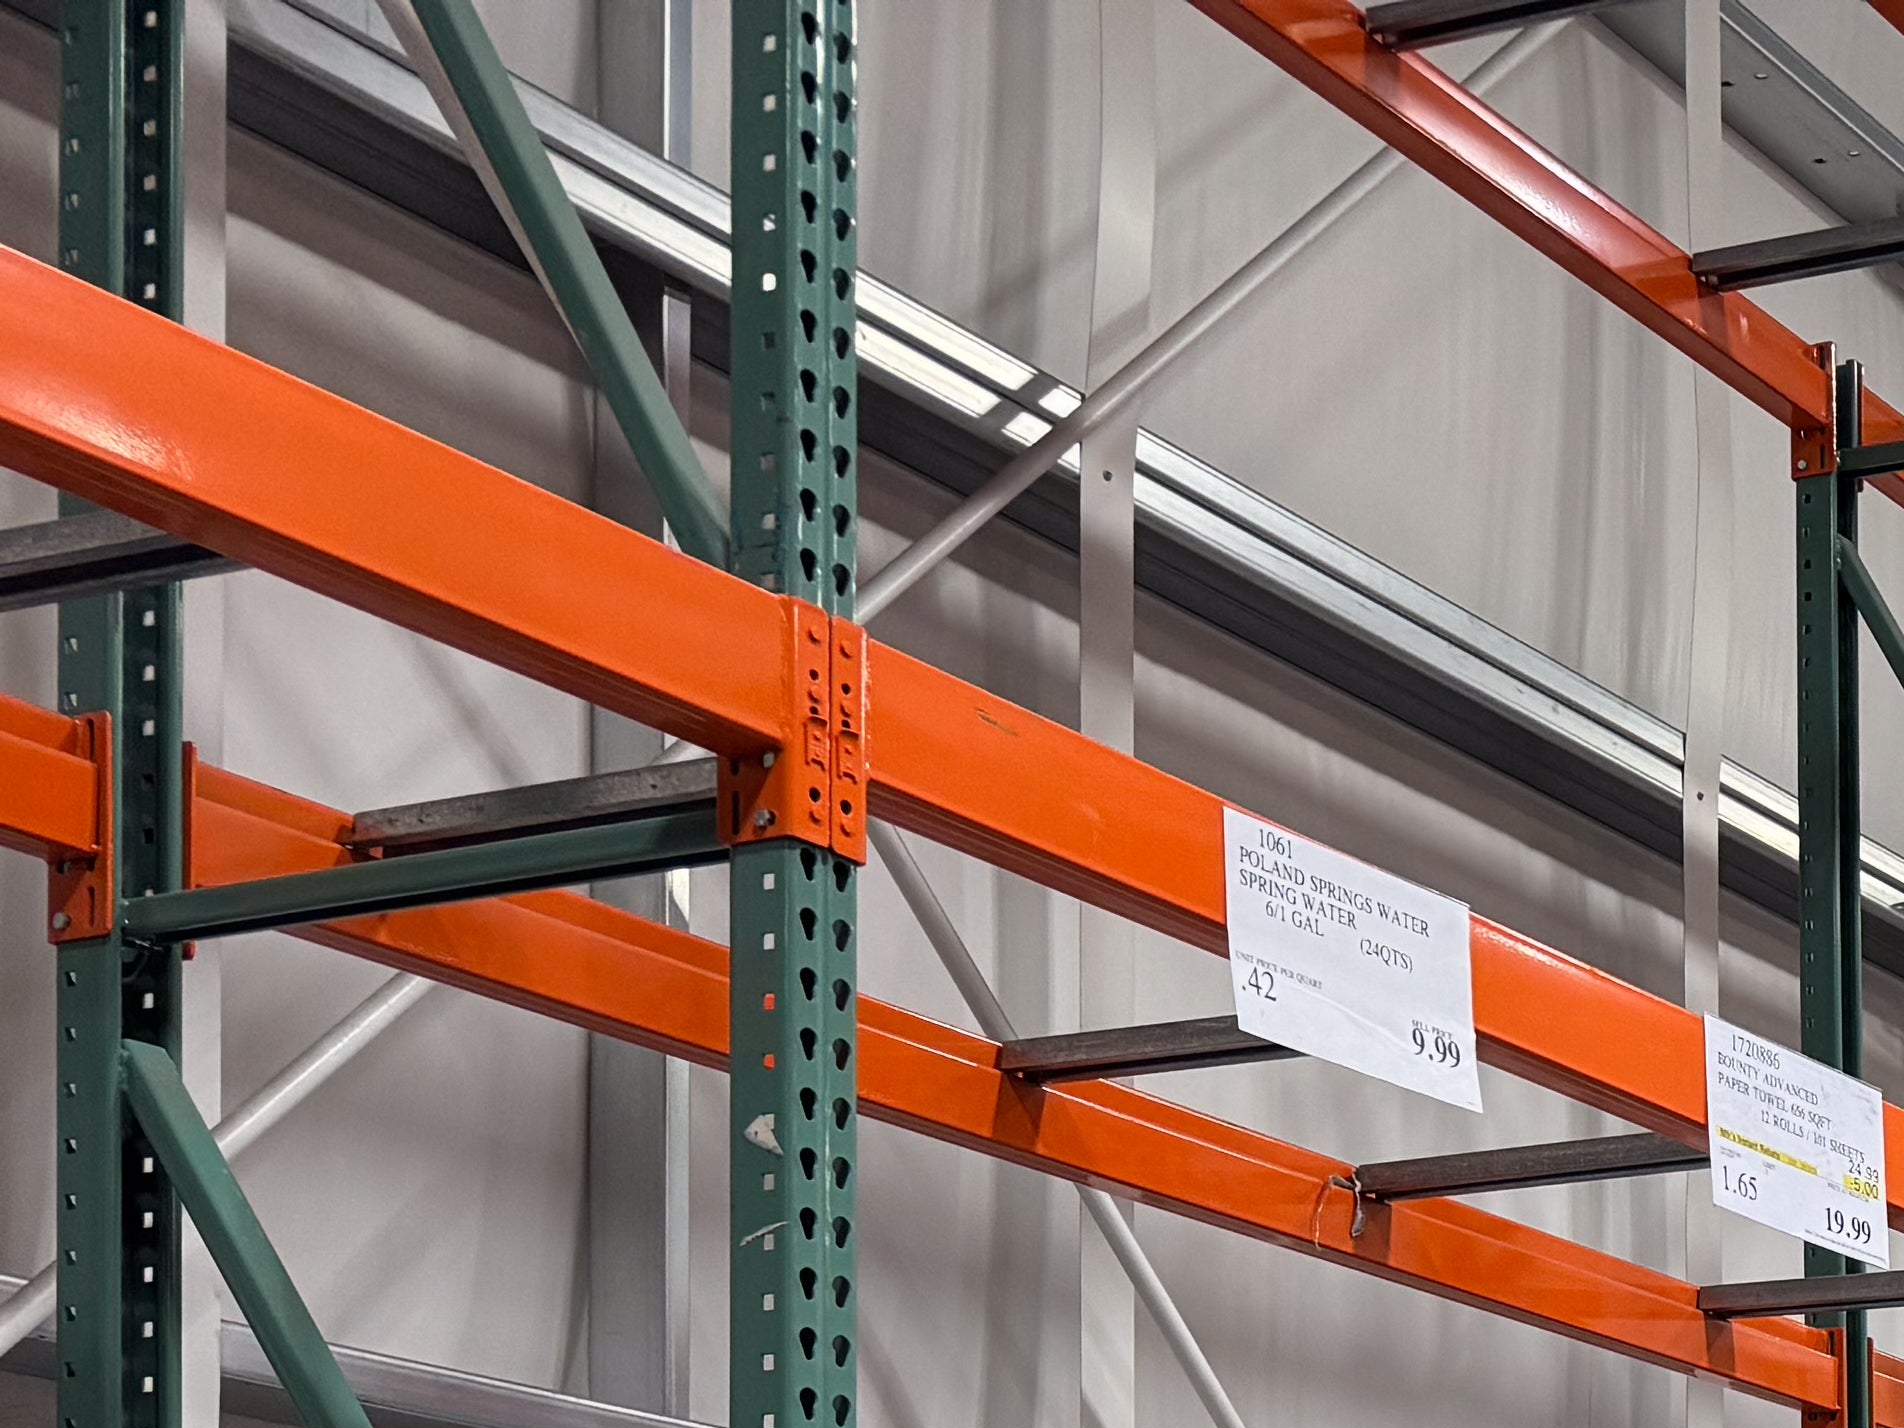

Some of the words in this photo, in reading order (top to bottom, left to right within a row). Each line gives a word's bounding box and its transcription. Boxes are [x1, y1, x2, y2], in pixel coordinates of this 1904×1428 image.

[1258, 829, 1293, 859] 1061
[1240, 846, 1305, 886] POLAND
[1310, 874, 1372, 913] SPRINGS
[1377, 903, 1429, 937] WATER
[1240, 870, 1297, 904] SPRING
[1303, 895, 1357, 930] WATER
[1266, 900, 1286, 922] 6/1
[1292, 911, 1324, 937] GAL
[1360, 939, 1413, 974] (24QTS)
[1242, 967, 1276, 1001] .42
[1412, 1028, 1461, 1068] 9.99
[1718, 1052, 1760, 1079] BOUNTY
[1763, 1072, 1818, 1105] ADVANCED
[1718, 1073, 1749, 1095] PAPER
[1753, 1086, 1788, 1112] TOWEL
[1808, 1112, 1832, 1130] SQFT
[1762, 1110, 1770, 1124] 12
[1774, 1116, 1804, 1138] ROLLS
[1830, 1138, 1865, 1163] SHEETS
[1723, 1165, 1757, 1201] 1.65
[1849, 1161, 1879, 1183] 24.99
[1850, 1179, 1879, 1199] -5.00
[1826, 1208, 1871, 1244] 19.99
